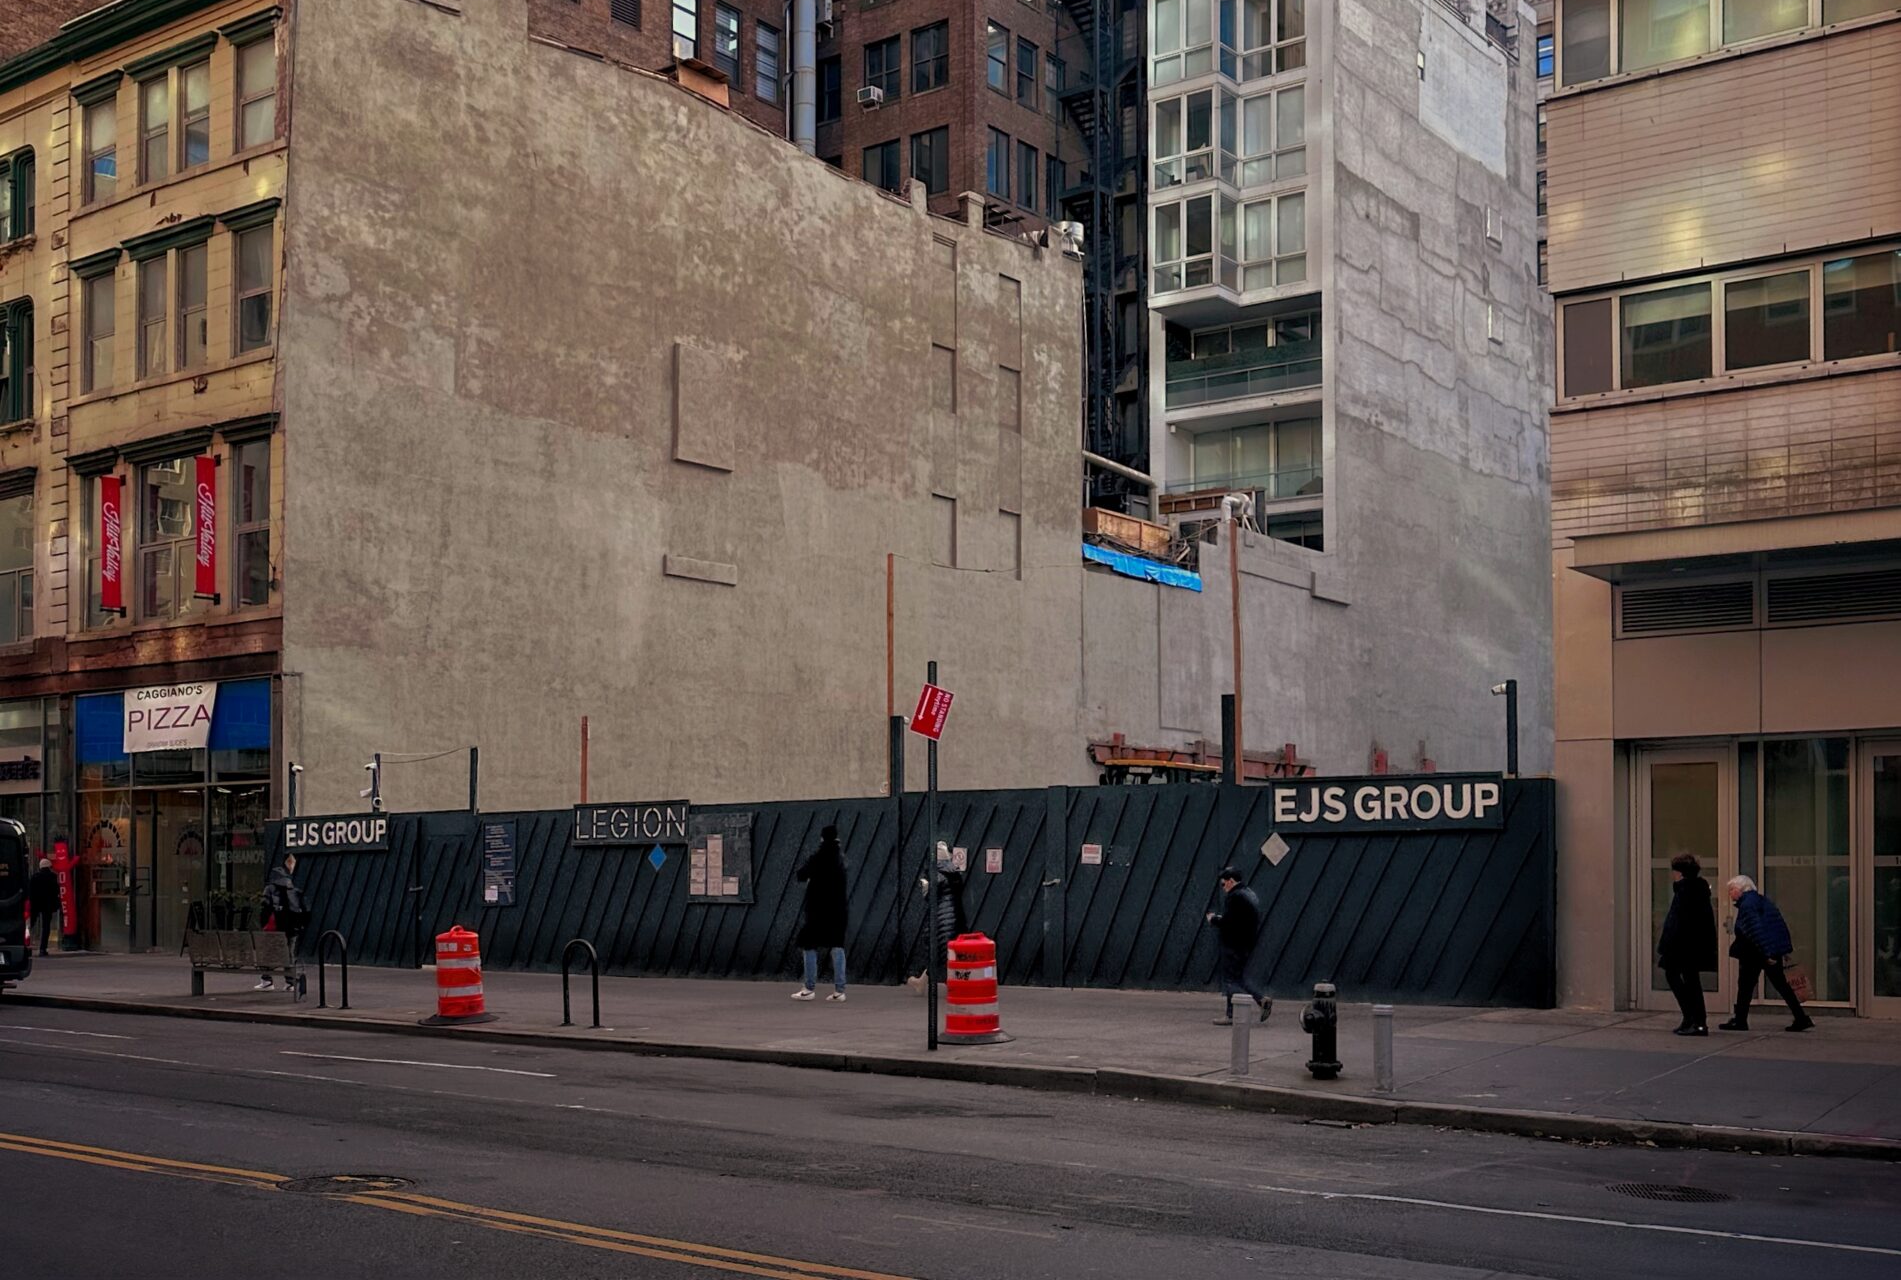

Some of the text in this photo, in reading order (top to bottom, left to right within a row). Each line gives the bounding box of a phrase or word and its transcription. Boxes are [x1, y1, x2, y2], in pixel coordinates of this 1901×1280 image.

[197, 483, 215, 567] Hill Valley
[102, 502, 120, 582] Hill Valley
[137, 685, 203, 701] CAGGIANO'S
[128, 704, 211, 732] PIZZA
[932, 703, 948, 733] STANDING
[1274, 783, 1499, 823] EJS GROUP
[286, 819, 386, 847] EJS GROUP
[575, 806, 686, 839] LEGION
